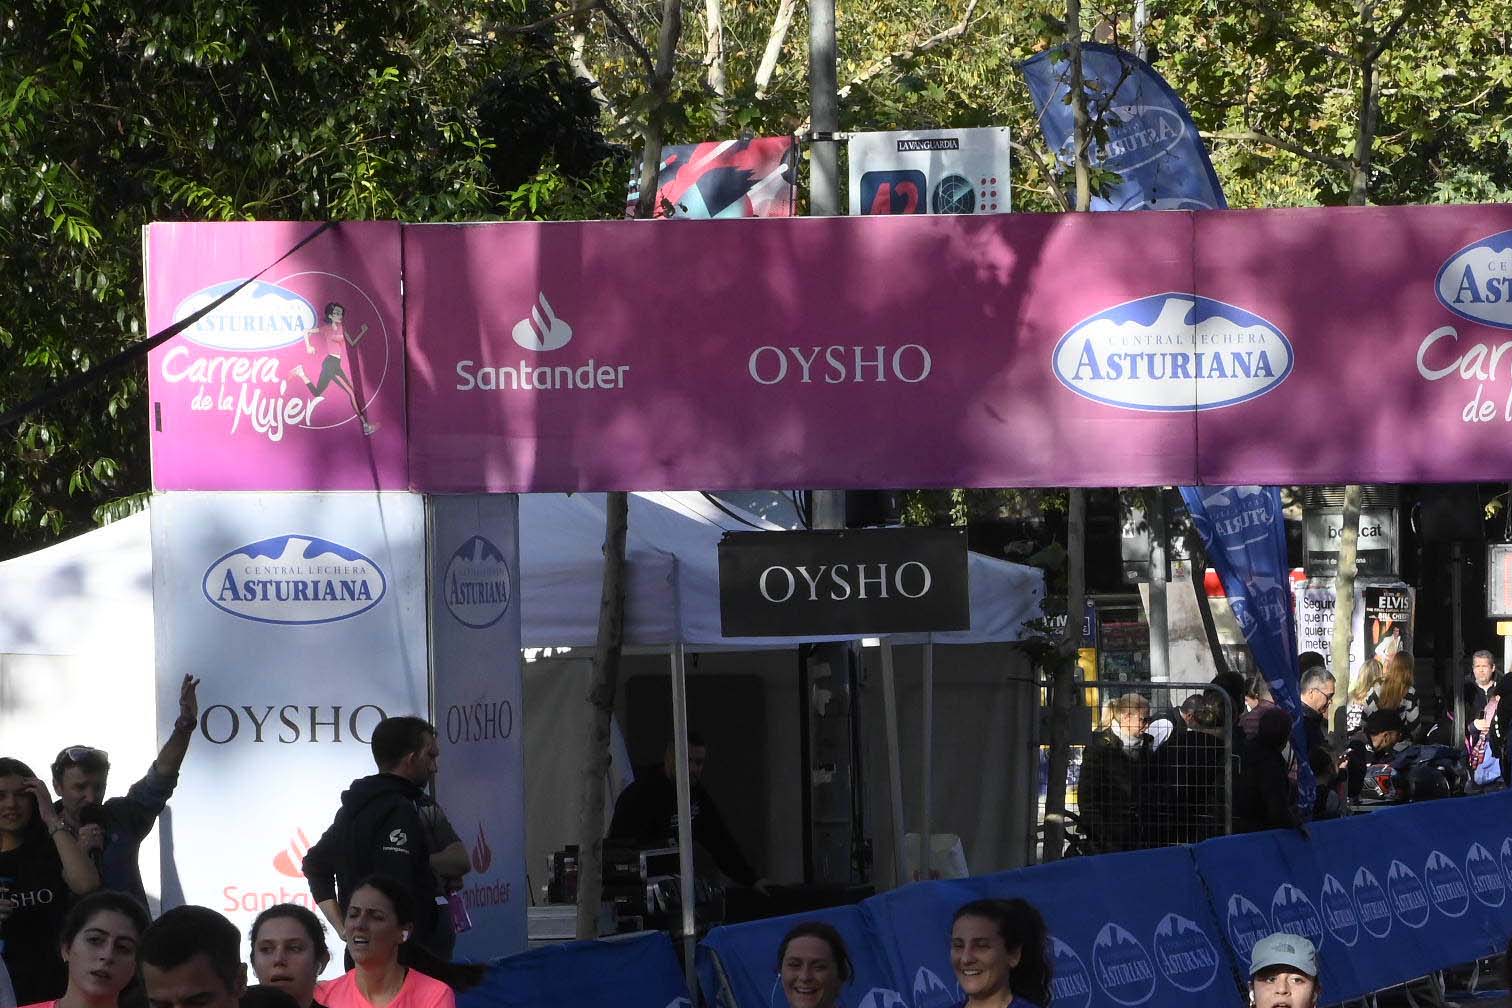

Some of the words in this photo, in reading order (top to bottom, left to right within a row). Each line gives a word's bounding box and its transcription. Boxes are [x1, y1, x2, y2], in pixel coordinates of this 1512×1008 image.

[1109, 334, 1183, 345] CENTRAL
[1190, 333, 1267, 344] LECHERA
[161, 346, 281, 384] Carrera
[456, 357, 630, 392] Santander
[748, 343, 932, 385] OYSHO
[1072, 338, 1276, 381] ASTURIANA
[191, 386, 214, 411] de
[218, 384, 234, 411] la
[231, 382, 326, 441] Mujer
[1462, 383, 1496, 423] de
[217, 569, 373, 602] ASTURIANA
[245, 566, 303, 576] CENTRAL
[308, 565, 367, 575] LECHERA
[759, 561, 932, 603] OYSHO
[450, 576, 507, 605] ASTURIANA
[1378, 596, 1409, 609] ELVIS
[200, 704, 388, 744] OYSHO
[447, 700, 513, 745] OYSHO
[223, 886, 317, 912] Santa
